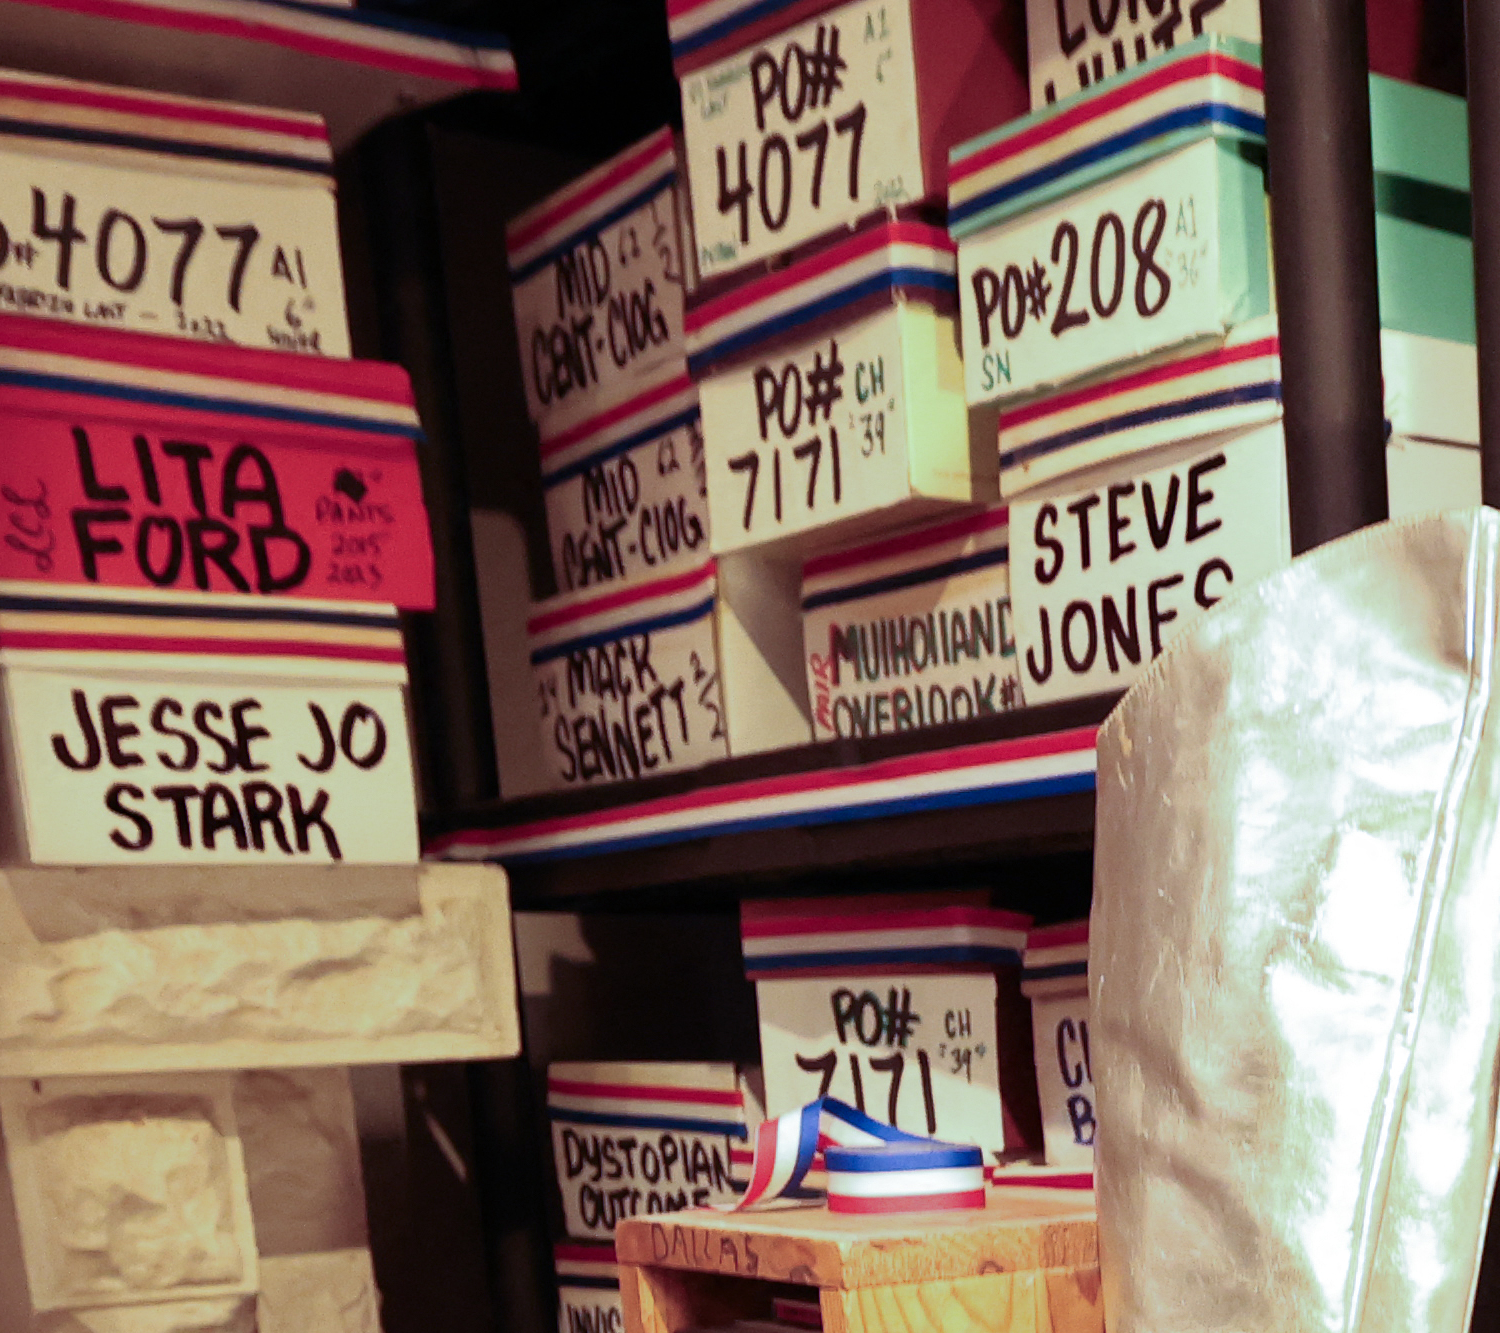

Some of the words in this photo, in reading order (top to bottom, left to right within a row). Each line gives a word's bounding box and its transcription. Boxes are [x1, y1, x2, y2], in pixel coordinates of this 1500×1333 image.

[751, 22, 847, 132] PO#
[716, 101, 867, 245] 4077
[753, 337, 844, 441] PO#
[855, 354, 885, 405] CH
[71, 426, 285, 526] LITA
[728, 424, 841, 531] 7171
[1034, 453, 1227, 585] STEVE
[71, 508, 311, 594] FORD
[567, 633, 658, 708] MACK
[51, 689, 271, 775] JESSE
[300, 701, 388, 771] JO
[555, 675, 689, 782] SENNETT
[107, 782, 344, 862] STARK
[830, 984, 920, 1048] PO#
[945, 1008, 972, 1040] CH
[795, 1049, 936, 1134] 7171
